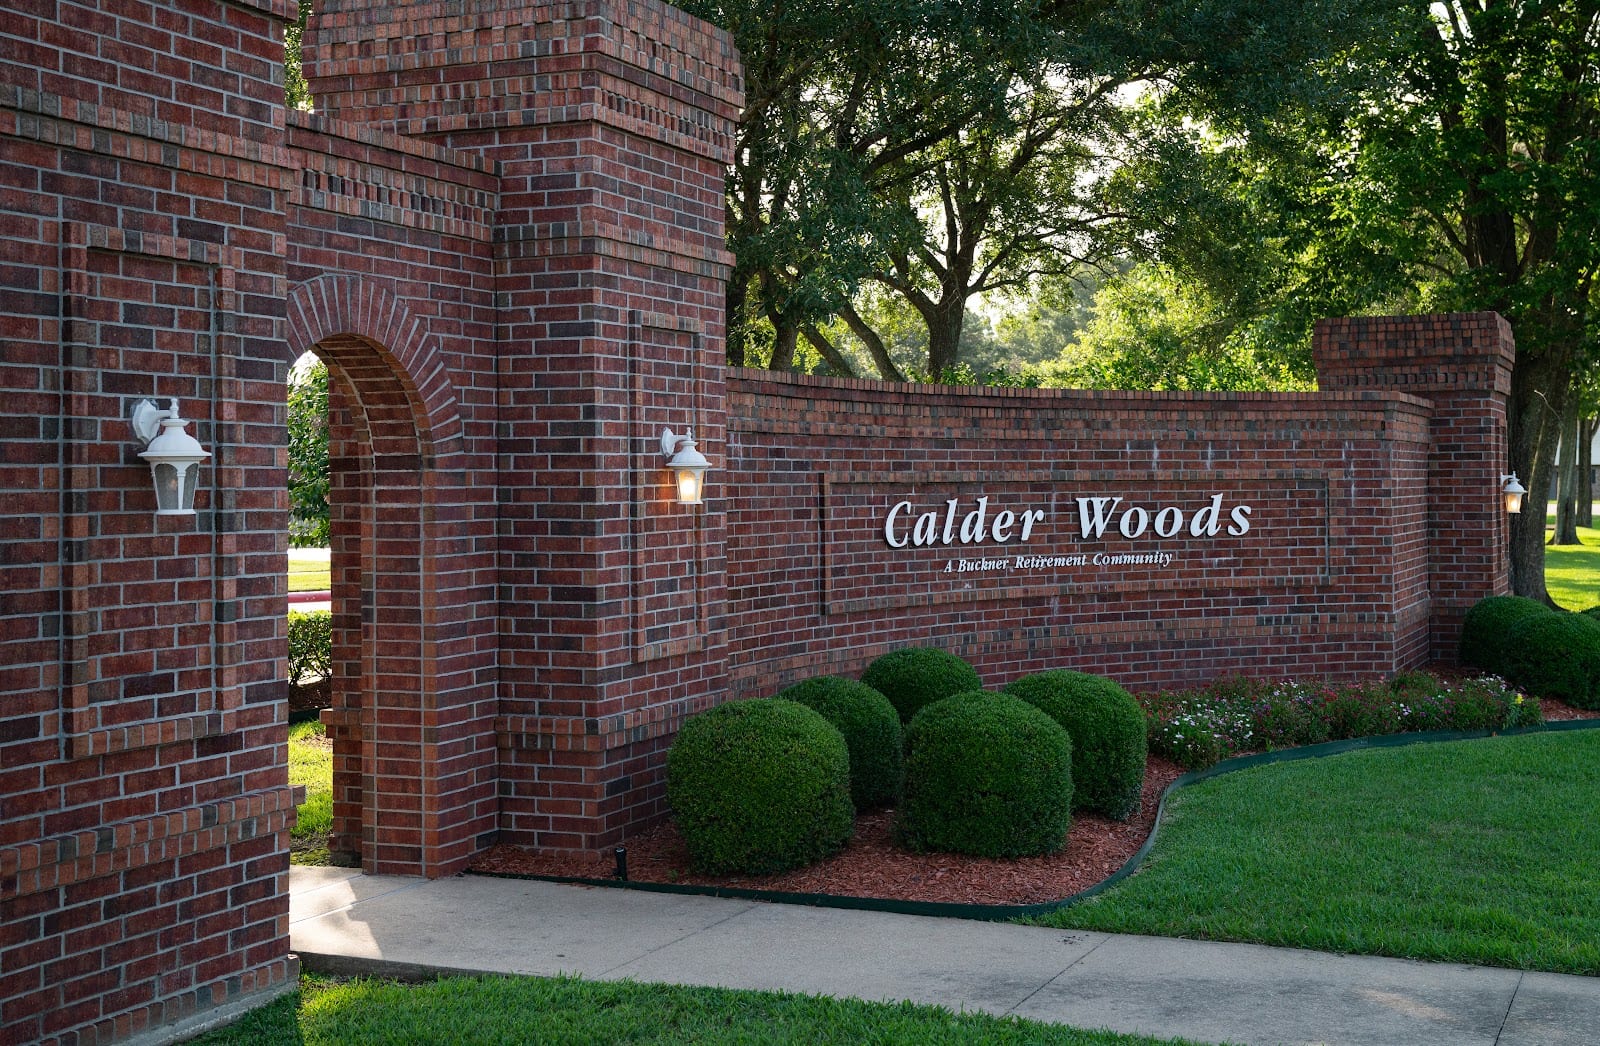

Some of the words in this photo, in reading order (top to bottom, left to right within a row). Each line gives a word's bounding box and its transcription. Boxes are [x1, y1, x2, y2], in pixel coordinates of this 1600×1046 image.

[885, 496, 1044, 548] Calder
[1075, 493, 1252, 539] Woods
[944, 560, 953, 573] A
[957, 557, 1009, 573] Buckner
[1014, 554, 1087, 569] Retirement
[1092, 551, 1173, 568] Community
